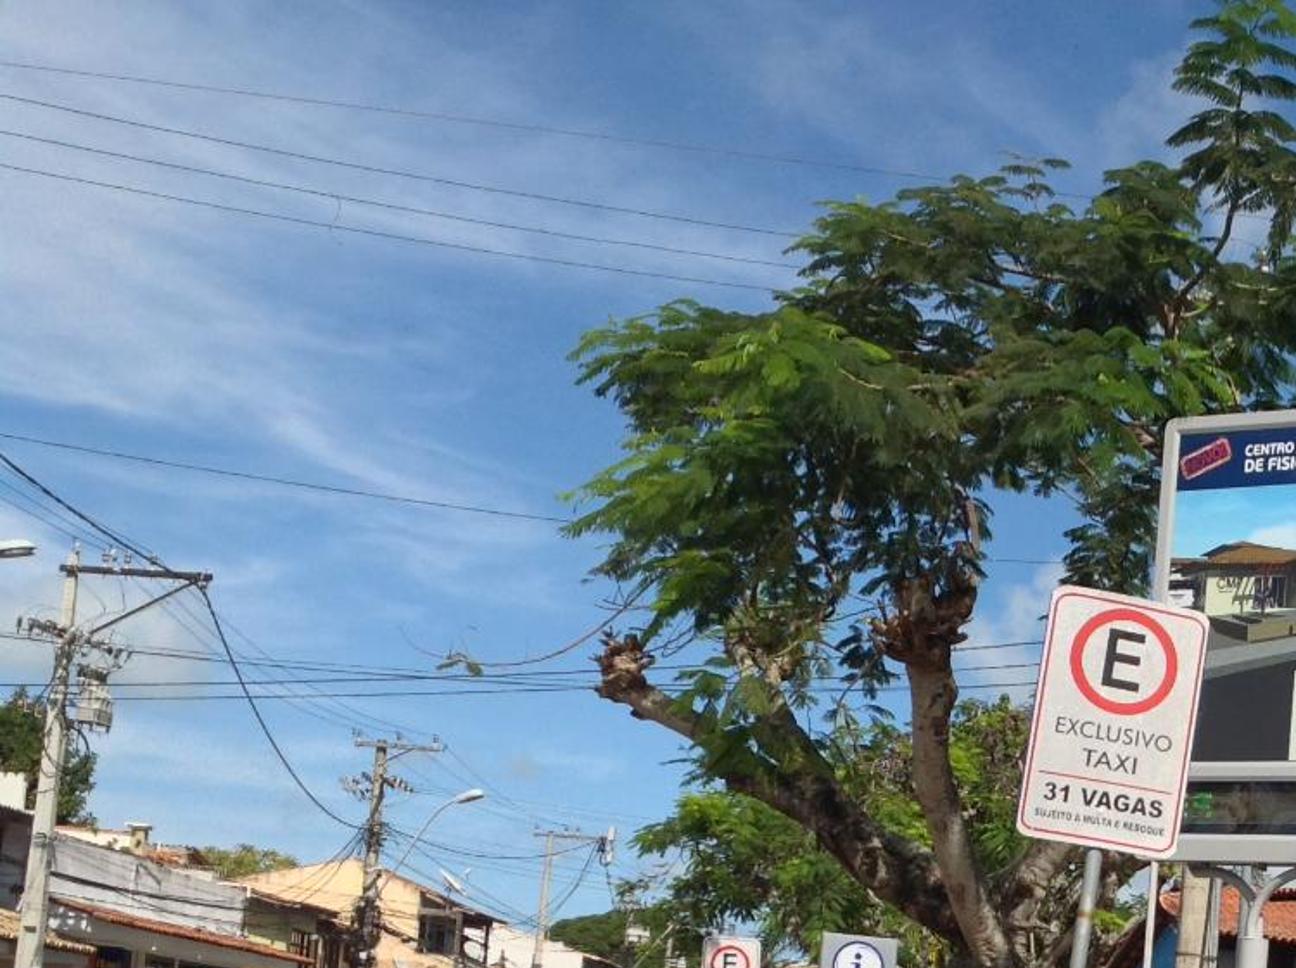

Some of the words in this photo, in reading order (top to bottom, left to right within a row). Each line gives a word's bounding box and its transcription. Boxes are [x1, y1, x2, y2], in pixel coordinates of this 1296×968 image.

[1245, 440, 1294, 457] CENTRO
[1244, 457, 1264, 473] DE
[1101, 628, 1146, 693] E
[1055, 716, 1173, 753] EXCLUSIVO
[1082, 748, 1139, 775] TAXI
[1043, 781, 1071, 803] 31
[1081, 787, 1164, 819] VAGAS
[1034, 807, 1073, 822] SUJEITO
[1083, 814, 1113, 828] MULTA
